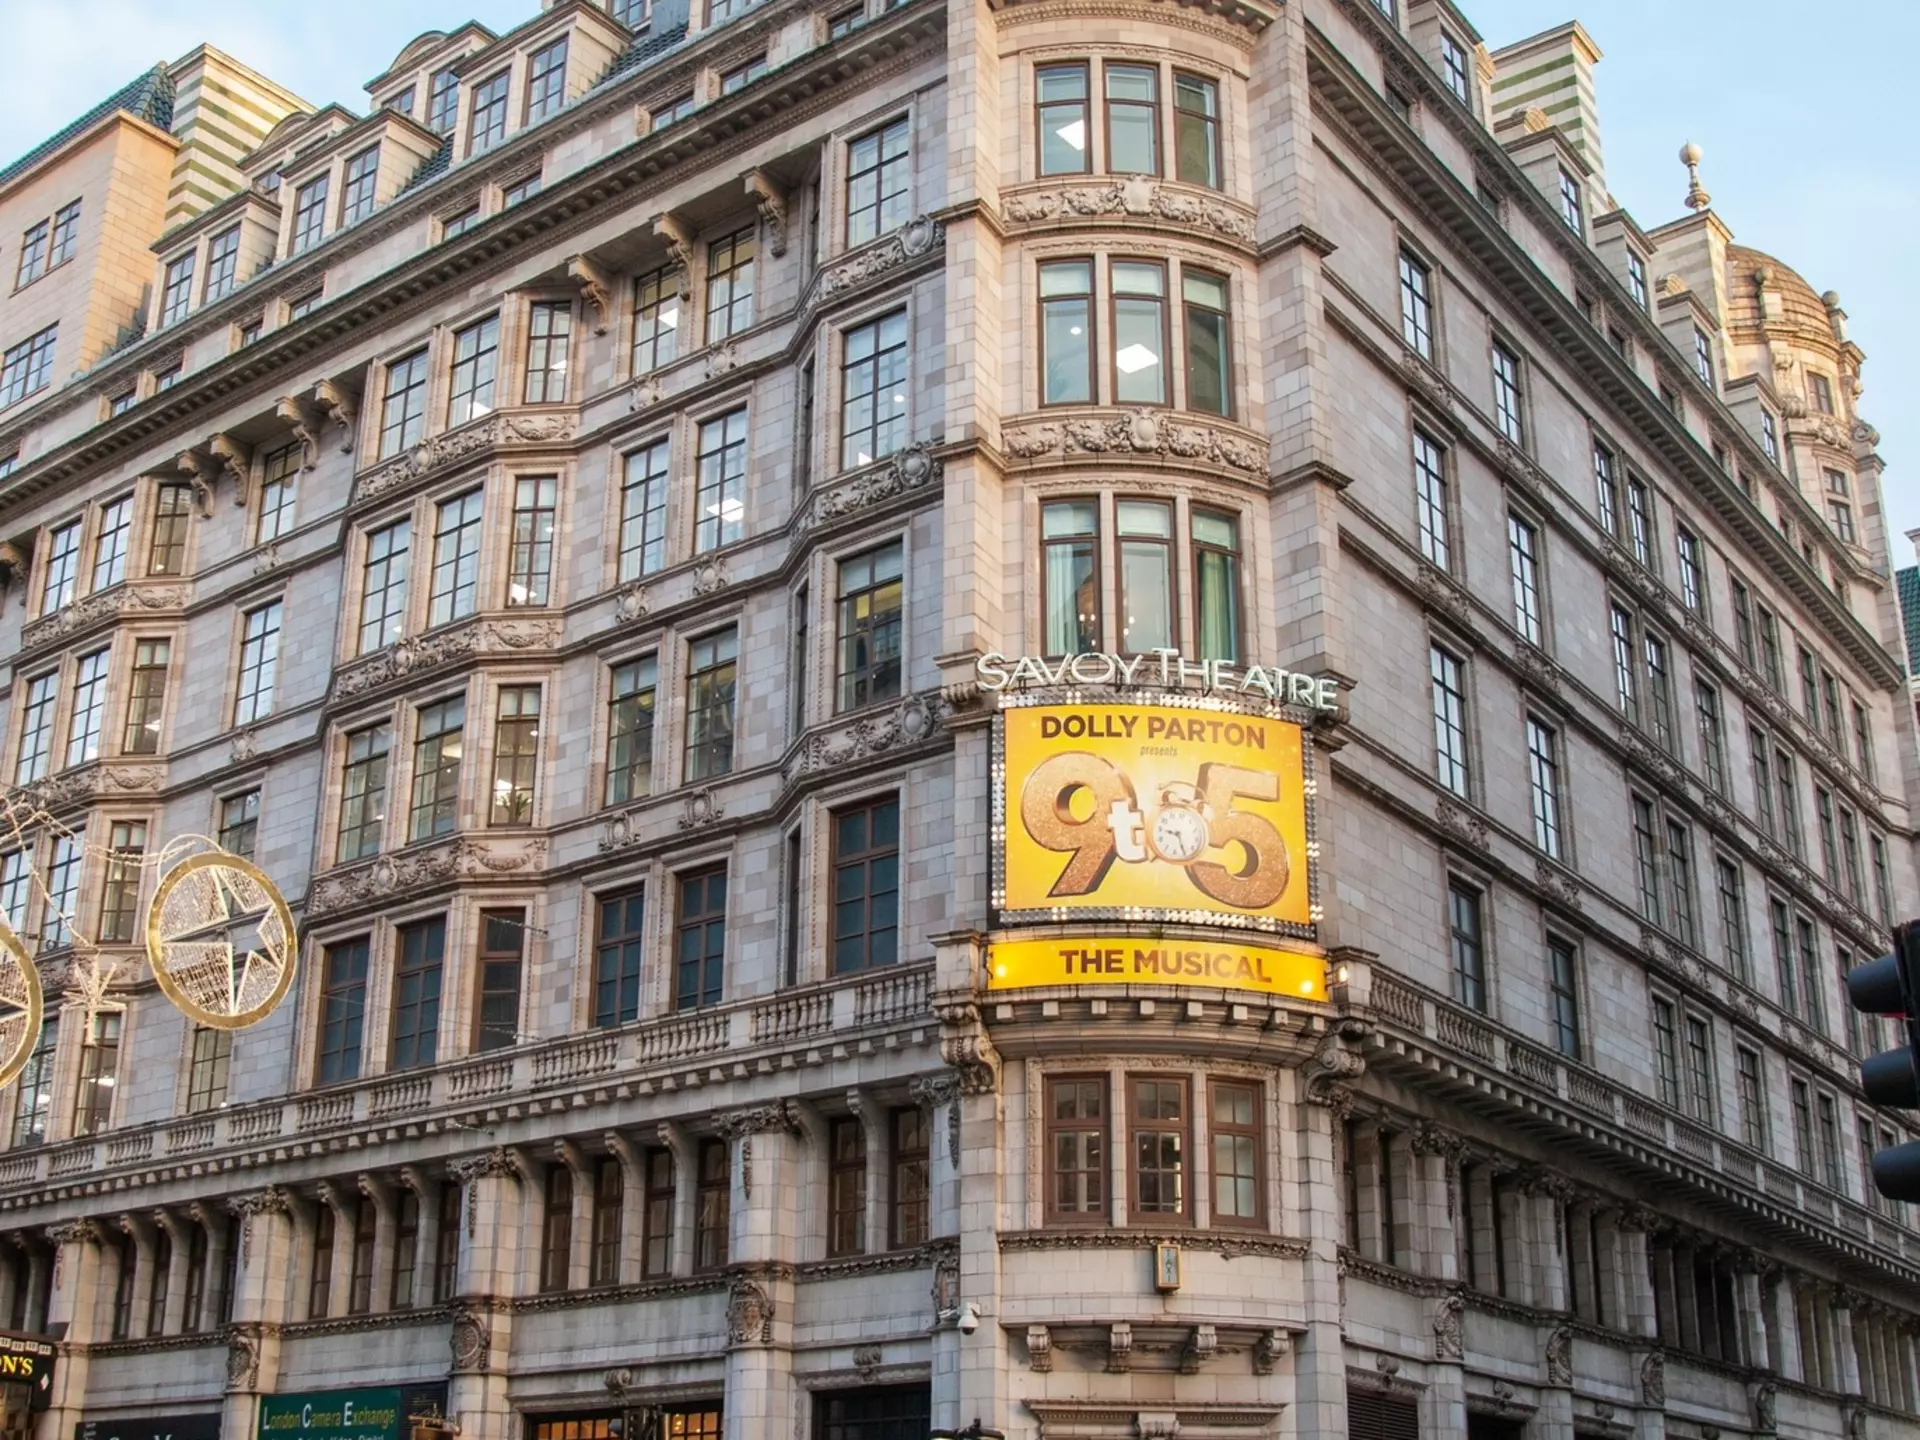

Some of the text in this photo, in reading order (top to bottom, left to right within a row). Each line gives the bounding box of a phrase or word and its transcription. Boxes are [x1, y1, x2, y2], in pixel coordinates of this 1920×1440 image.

[977, 647, 1339, 711] SAVOY THEATRE
[1041, 714, 1265, 749] DOLLY PARTON
[1139, 744, 1178, 757] presents
[1059, 949, 1272, 983] THE MUSICAL
[0, 1353, 34, 1376] N'S
[263, 1401, 396, 1430] London Camera Exchange
